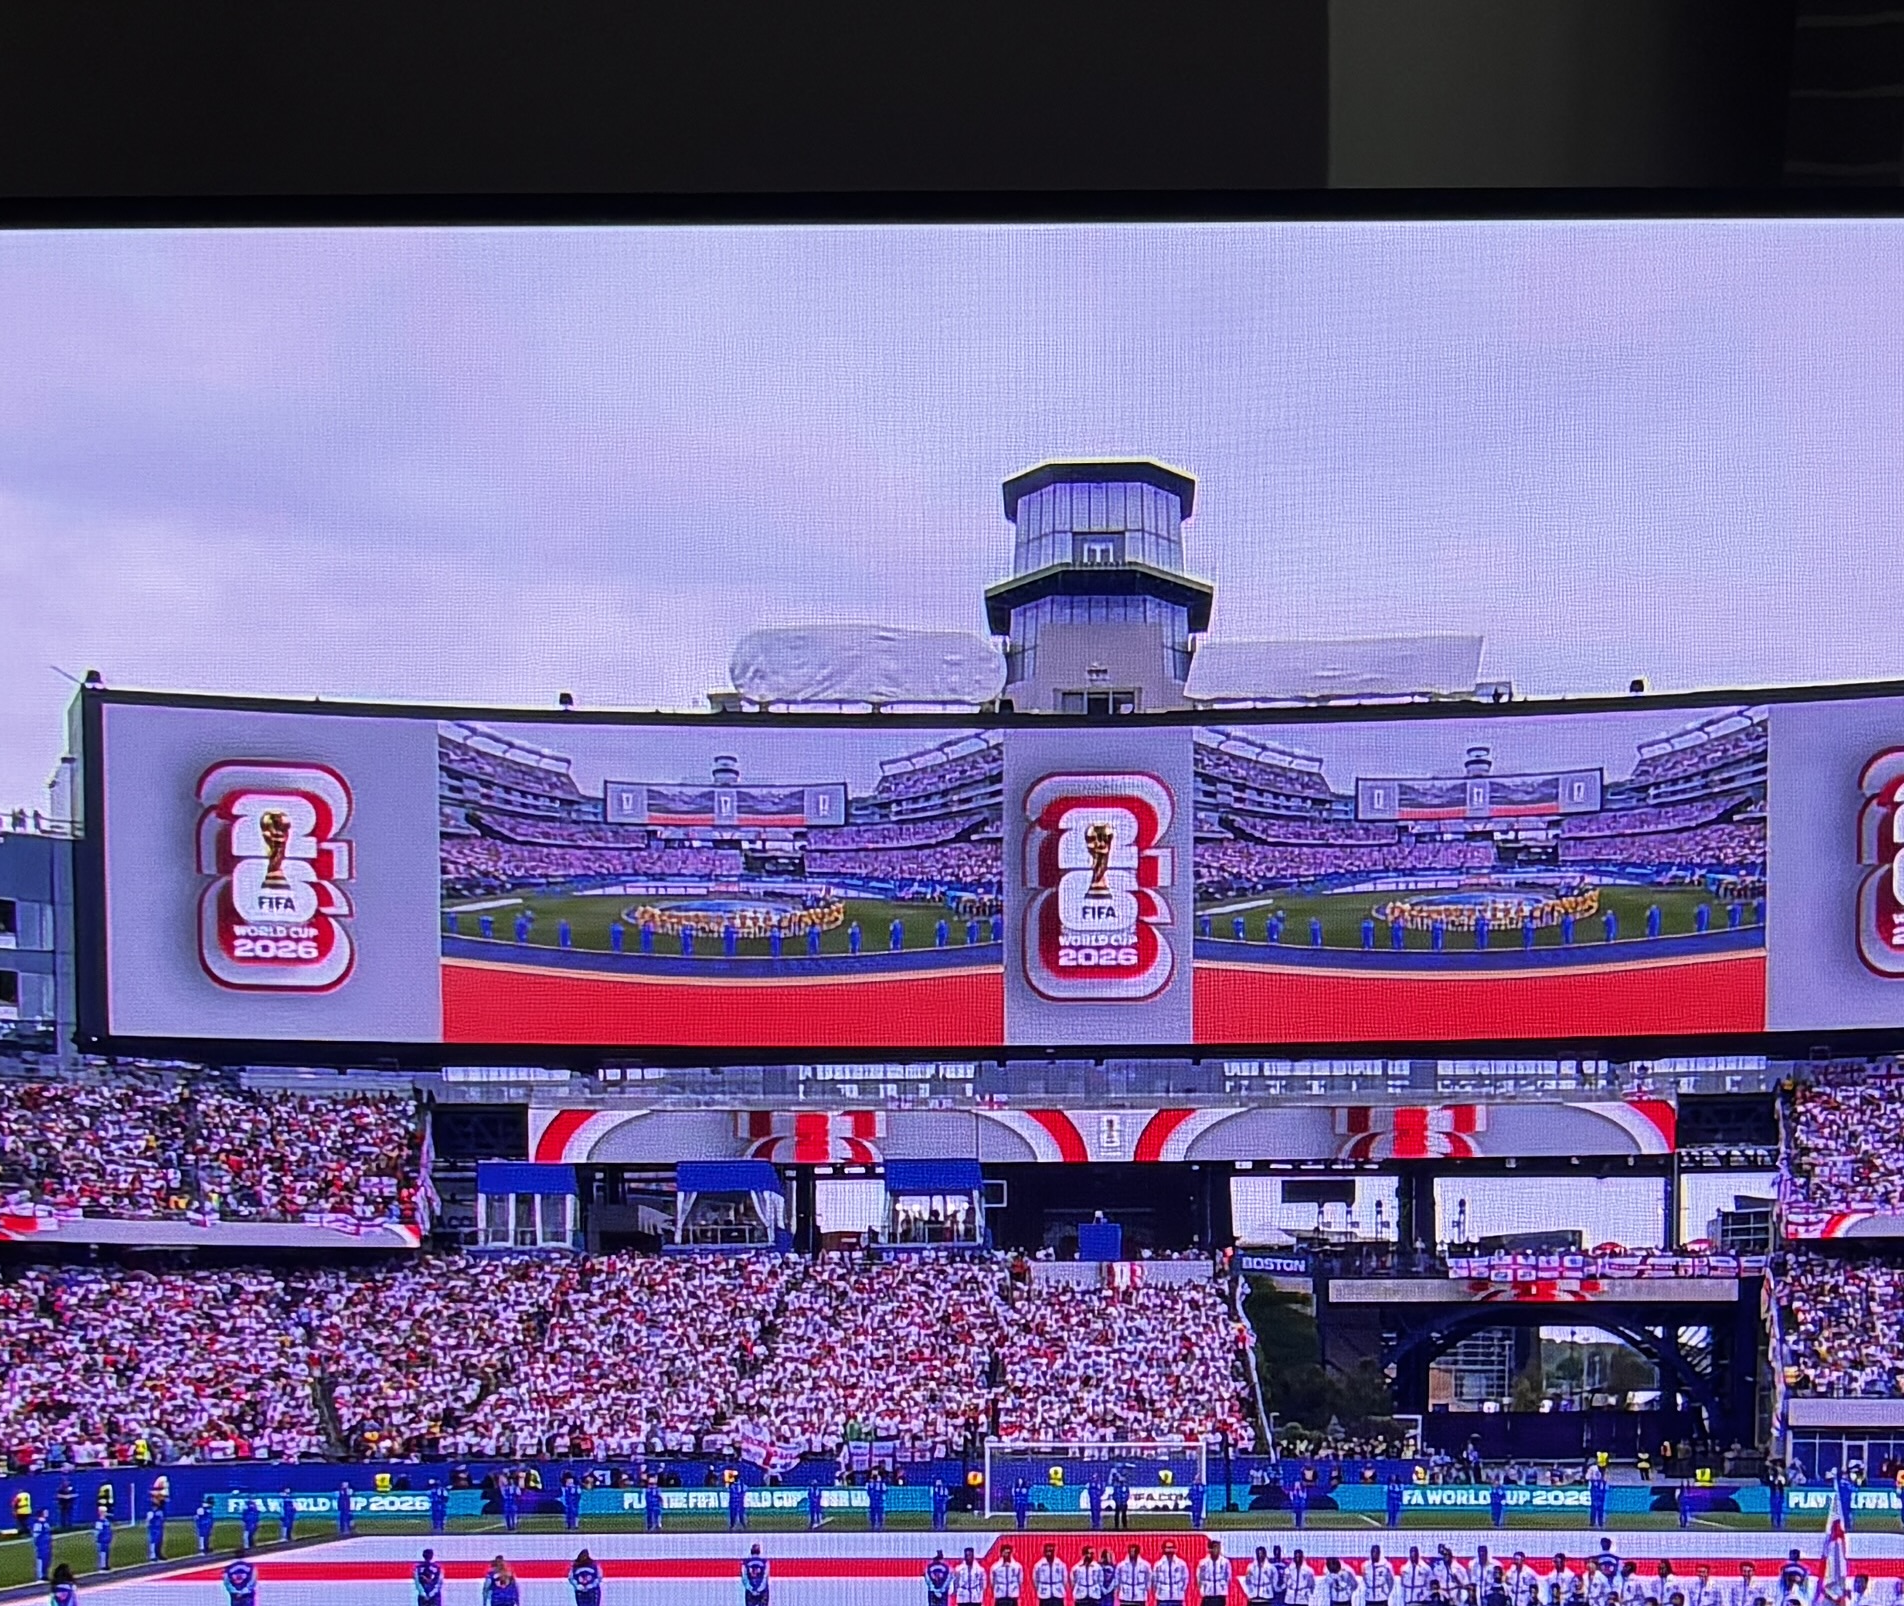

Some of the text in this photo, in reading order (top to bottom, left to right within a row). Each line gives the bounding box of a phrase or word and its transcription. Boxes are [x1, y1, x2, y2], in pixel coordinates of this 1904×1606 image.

[258, 896, 295, 910] FIFA
[1082, 906, 1116, 919] FIFA
[233, 925, 319, 938] WORLD CUP
[1059, 934, 1138, 946] WORLD CUP
[233, 938, 319, 958] 2026
[1058, 948, 1138, 966] 2026
[369, 1496, 432, 1511] 2026
